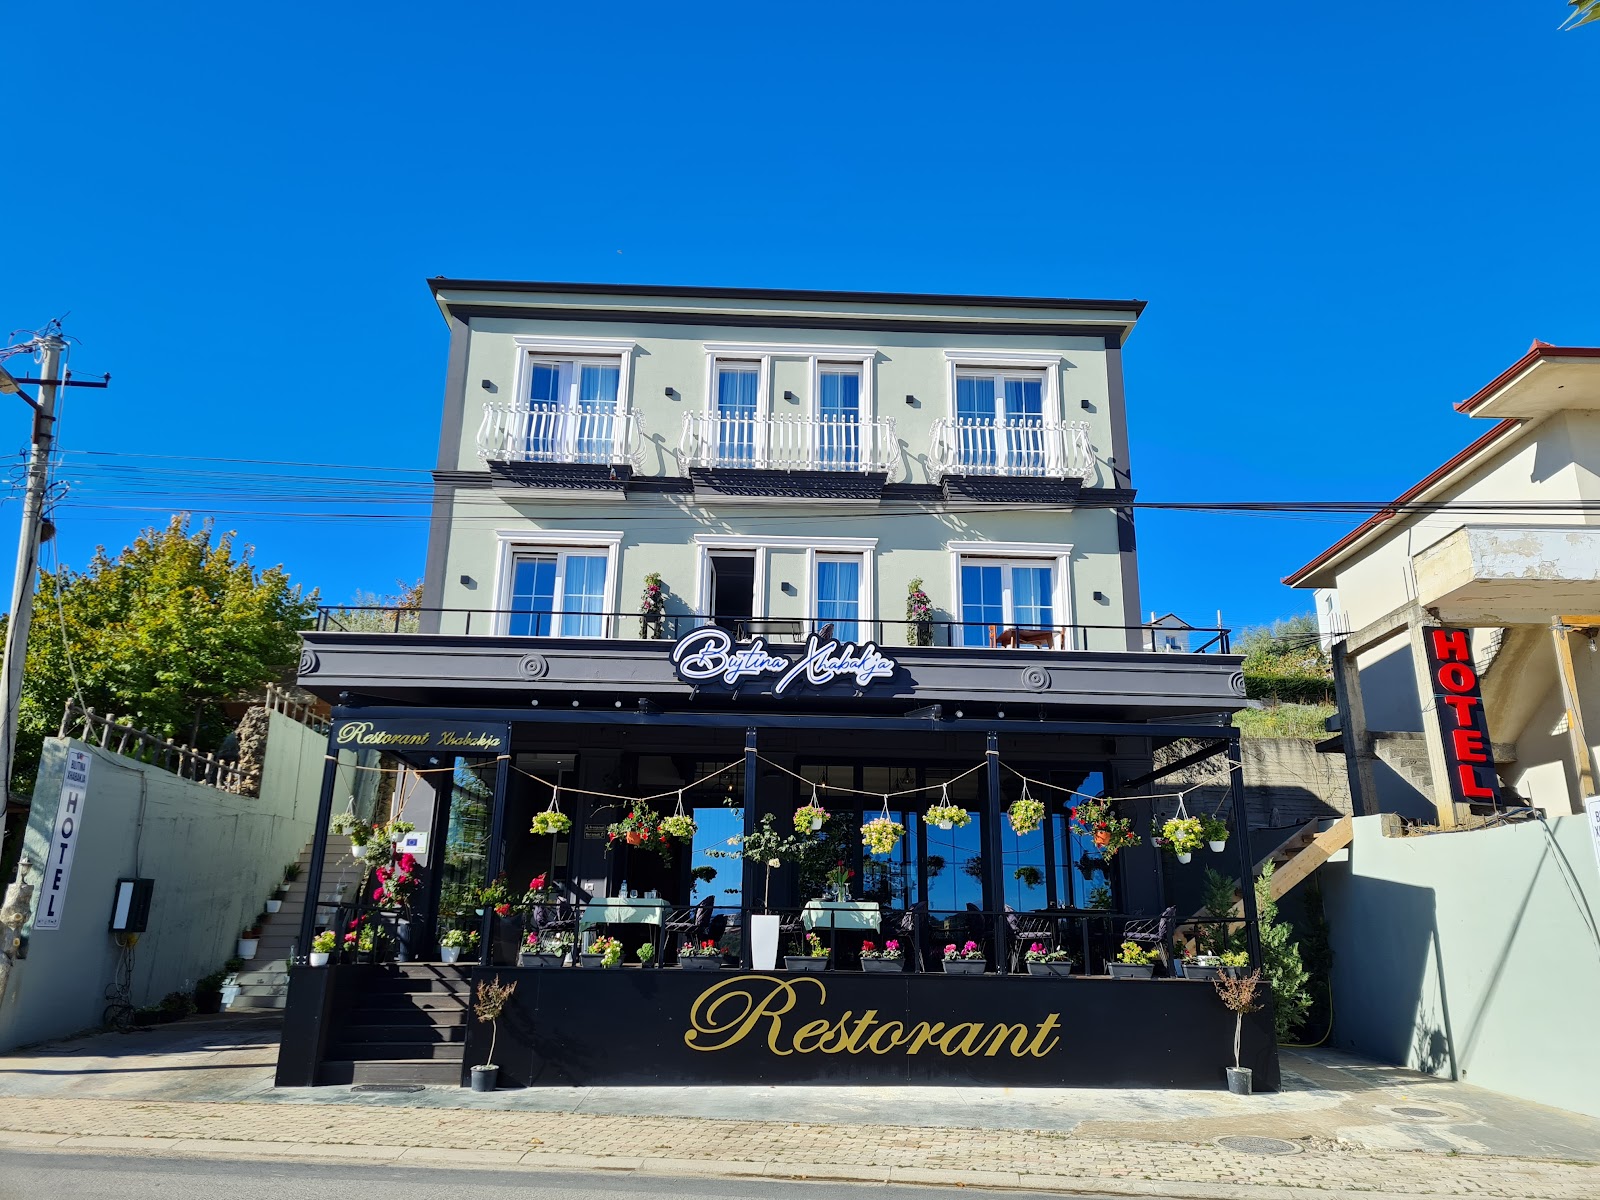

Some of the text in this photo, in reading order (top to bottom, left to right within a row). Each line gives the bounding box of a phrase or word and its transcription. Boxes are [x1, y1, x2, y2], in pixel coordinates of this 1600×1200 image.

[673, 628, 895, 694] Bujtina Xhabakja
[337, 721, 501, 750] Restorant Xhabakja
[1432, 630, 1493, 798] HOTEL
[47, 791, 79, 917] HOTEL
[684, 974, 1062, 1057] Restorant
